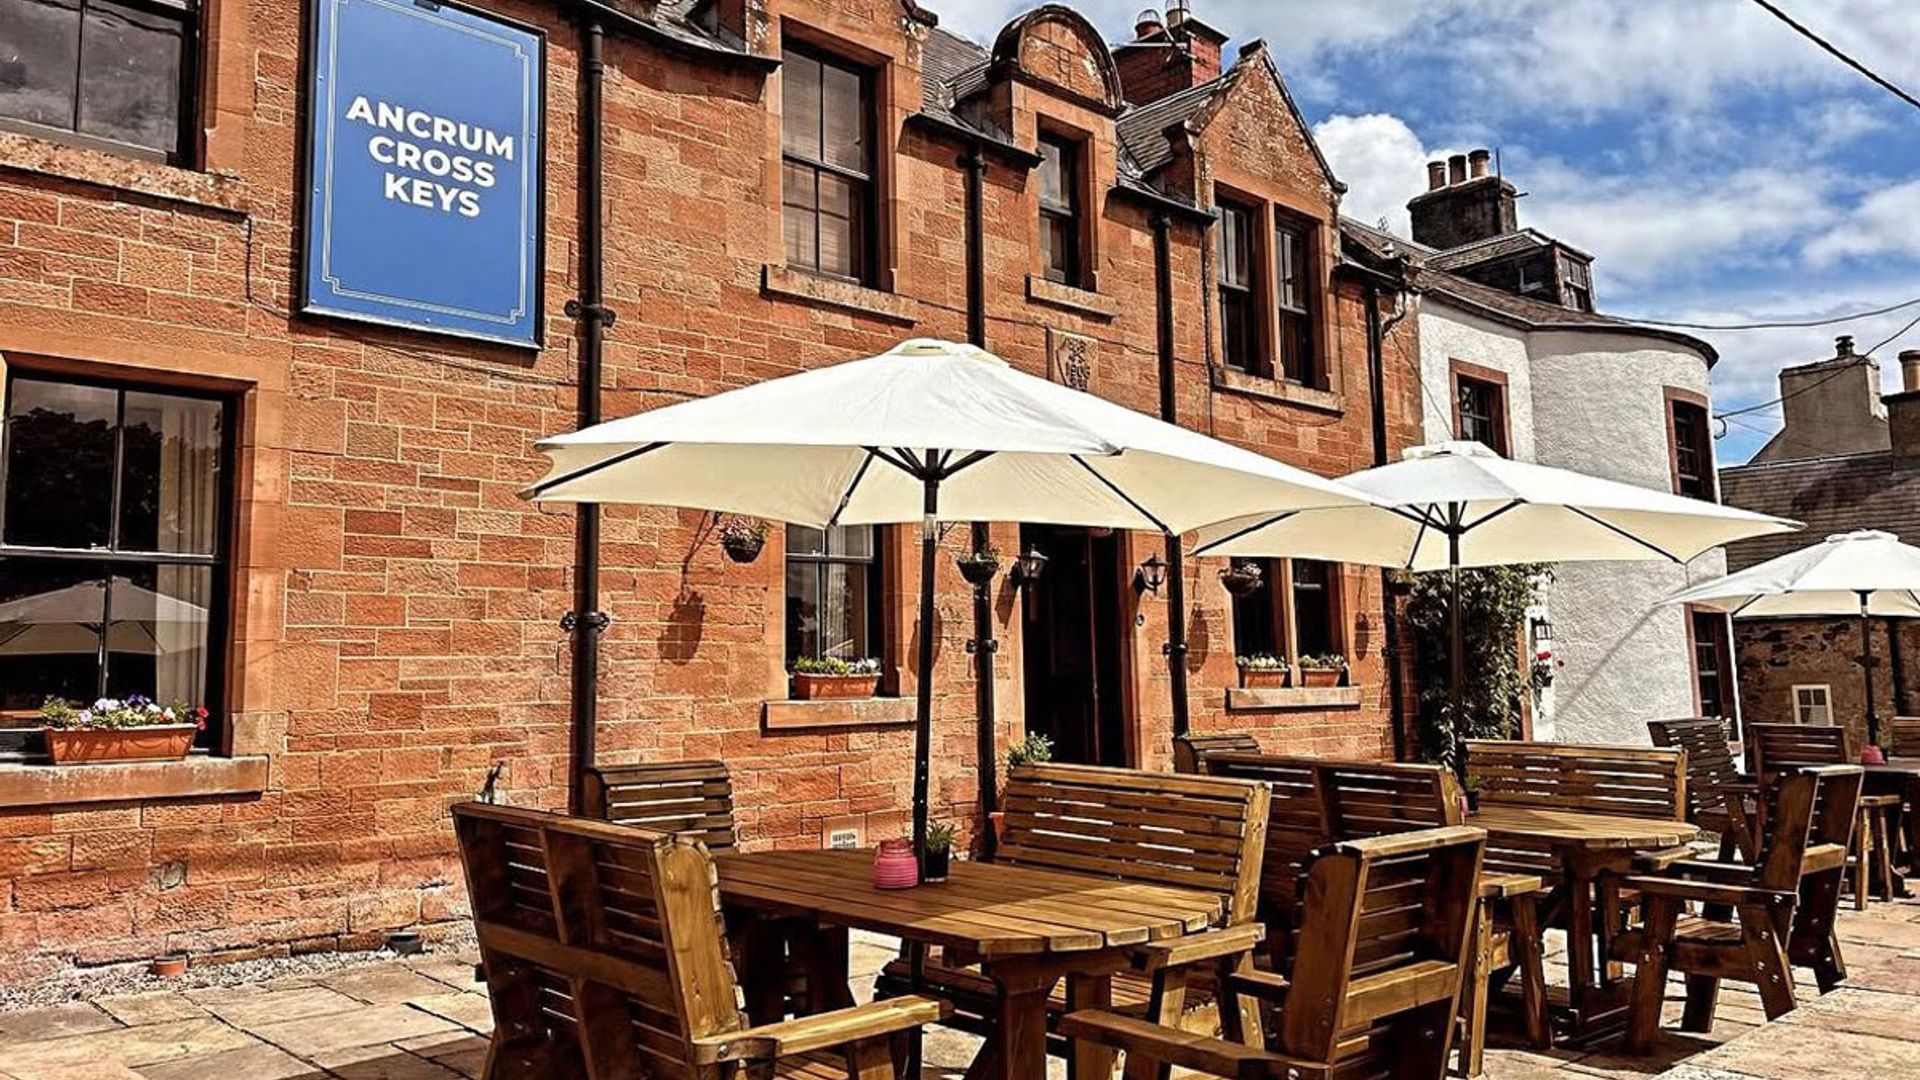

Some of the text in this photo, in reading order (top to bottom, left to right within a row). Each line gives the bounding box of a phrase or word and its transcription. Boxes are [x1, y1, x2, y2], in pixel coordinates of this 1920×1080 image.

[346, 96, 514, 160] ANCRUM
[369, 136, 496, 188] CROSS
[385, 172, 481, 218] KEYS
